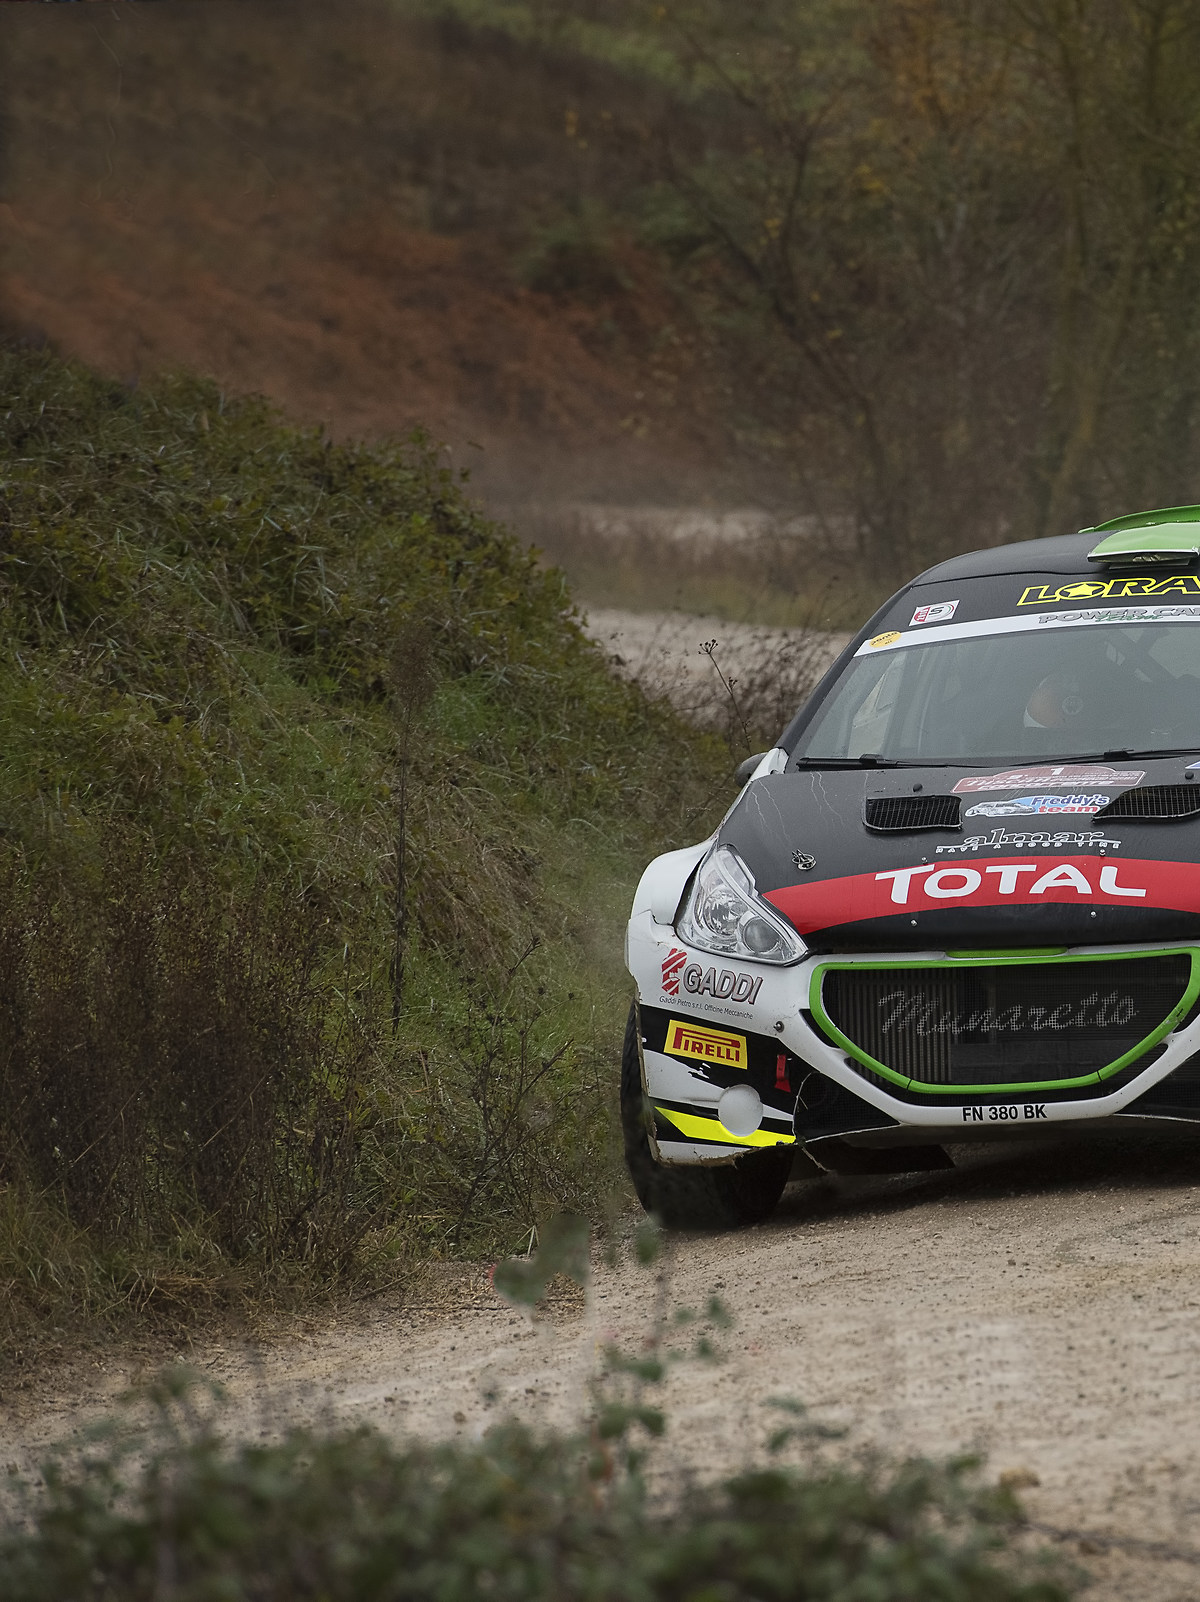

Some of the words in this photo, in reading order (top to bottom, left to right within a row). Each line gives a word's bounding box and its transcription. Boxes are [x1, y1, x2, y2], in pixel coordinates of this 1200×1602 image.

[1038, 608, 1149, 624] POWER
[1031, 795, 1110, 807] Freddy's
[1038, 805, 1099, 814] team
[874, 863, 1147, 904] TOTAL
[683, 963, 763, 1005] GADDI
[659, 995, 677, 1005] Gaddi
[676, 998, 692, 1008] Pietro
[704, 1003, 723, 1014] Officine
[724, 1007, 754, 1020] Meccaniche
[878, 990, 1138, 1036] Munaretto
[672, 1026, 741, 1062] PIRELLI
[962, 1106, 984, 1122] FN
[988, 1105, 1018, 1121] 380
[1023, 1104, 1048, 1120] BK
